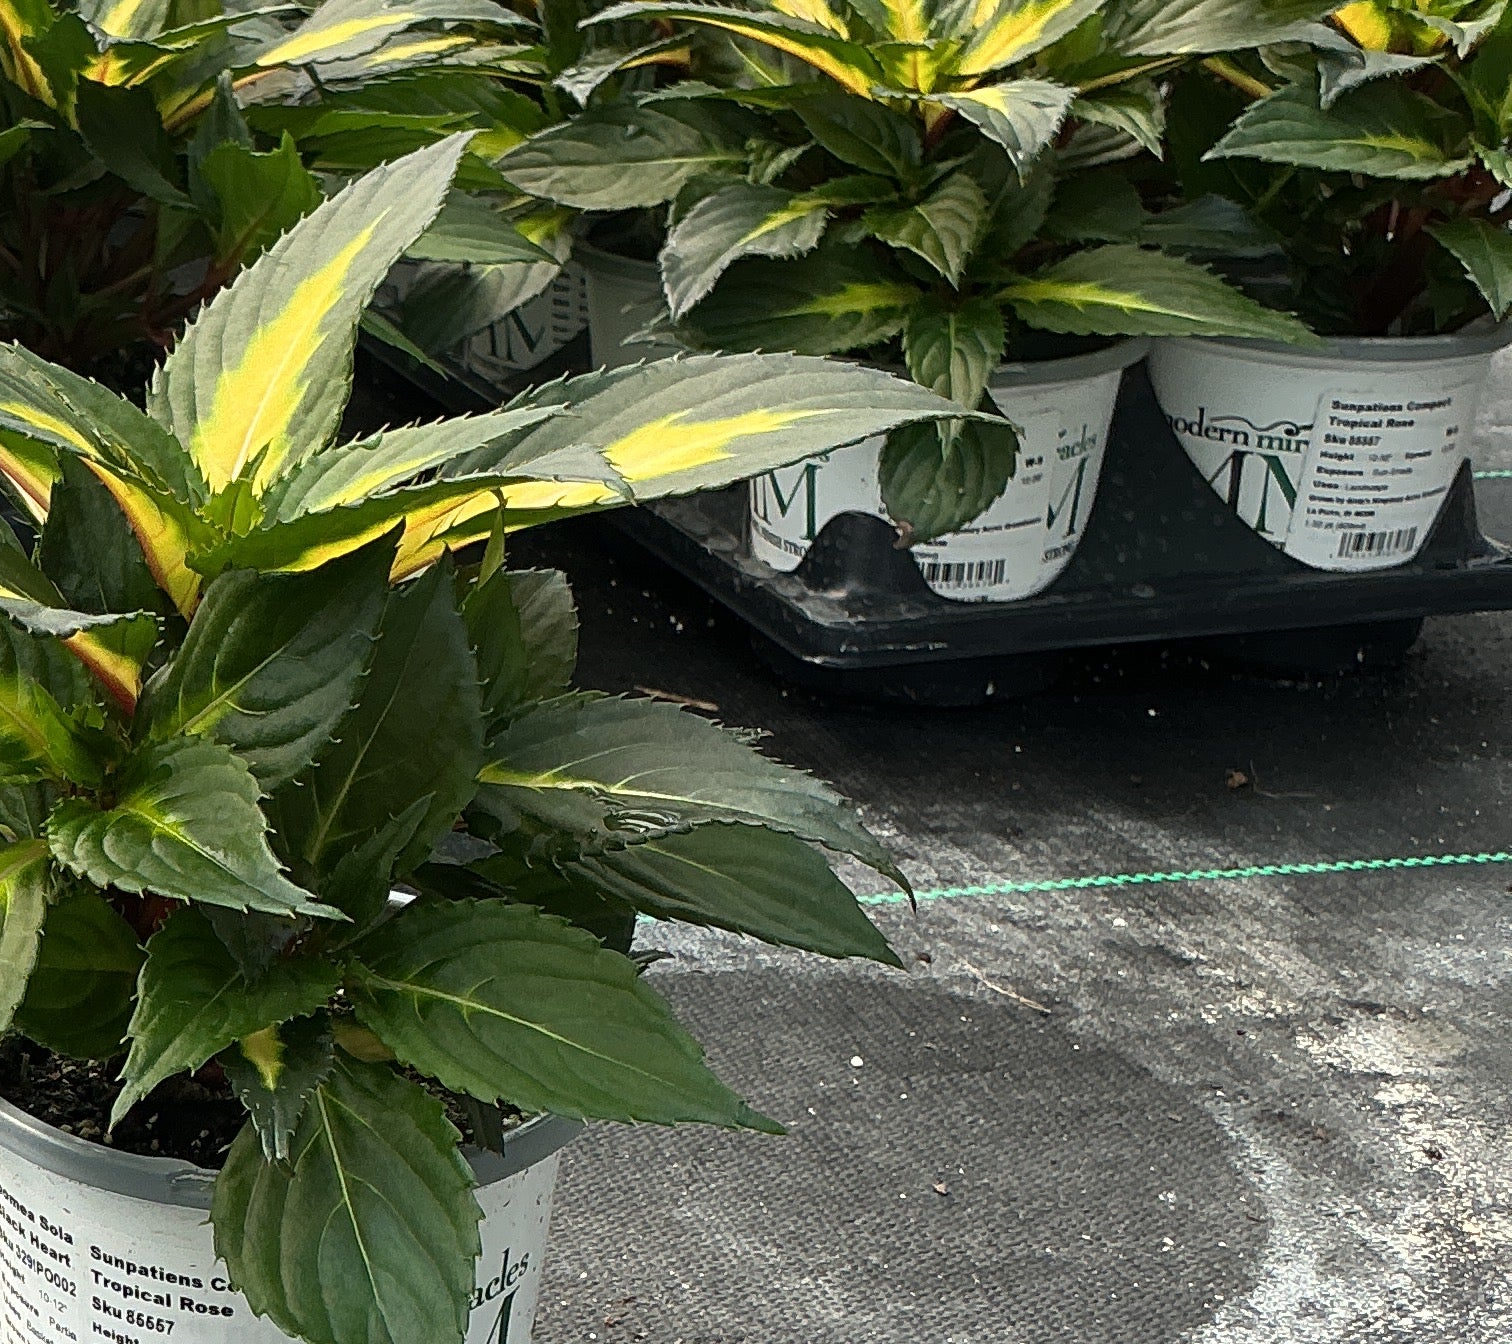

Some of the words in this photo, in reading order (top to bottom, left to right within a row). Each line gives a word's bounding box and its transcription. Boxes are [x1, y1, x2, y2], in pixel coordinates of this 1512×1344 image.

[1255, 434, 1311, 454] mir
[29, 1230, 72, 1268] Heart
[89, 1245, 204, 1289] Sunpatiens
[90, 1268, 172, 1308] Tropical
[179, 1296, 235, 1318] Rose
[469, 1247, 530, 1311] acles
[91, 1295, 123, 1320] Sku
